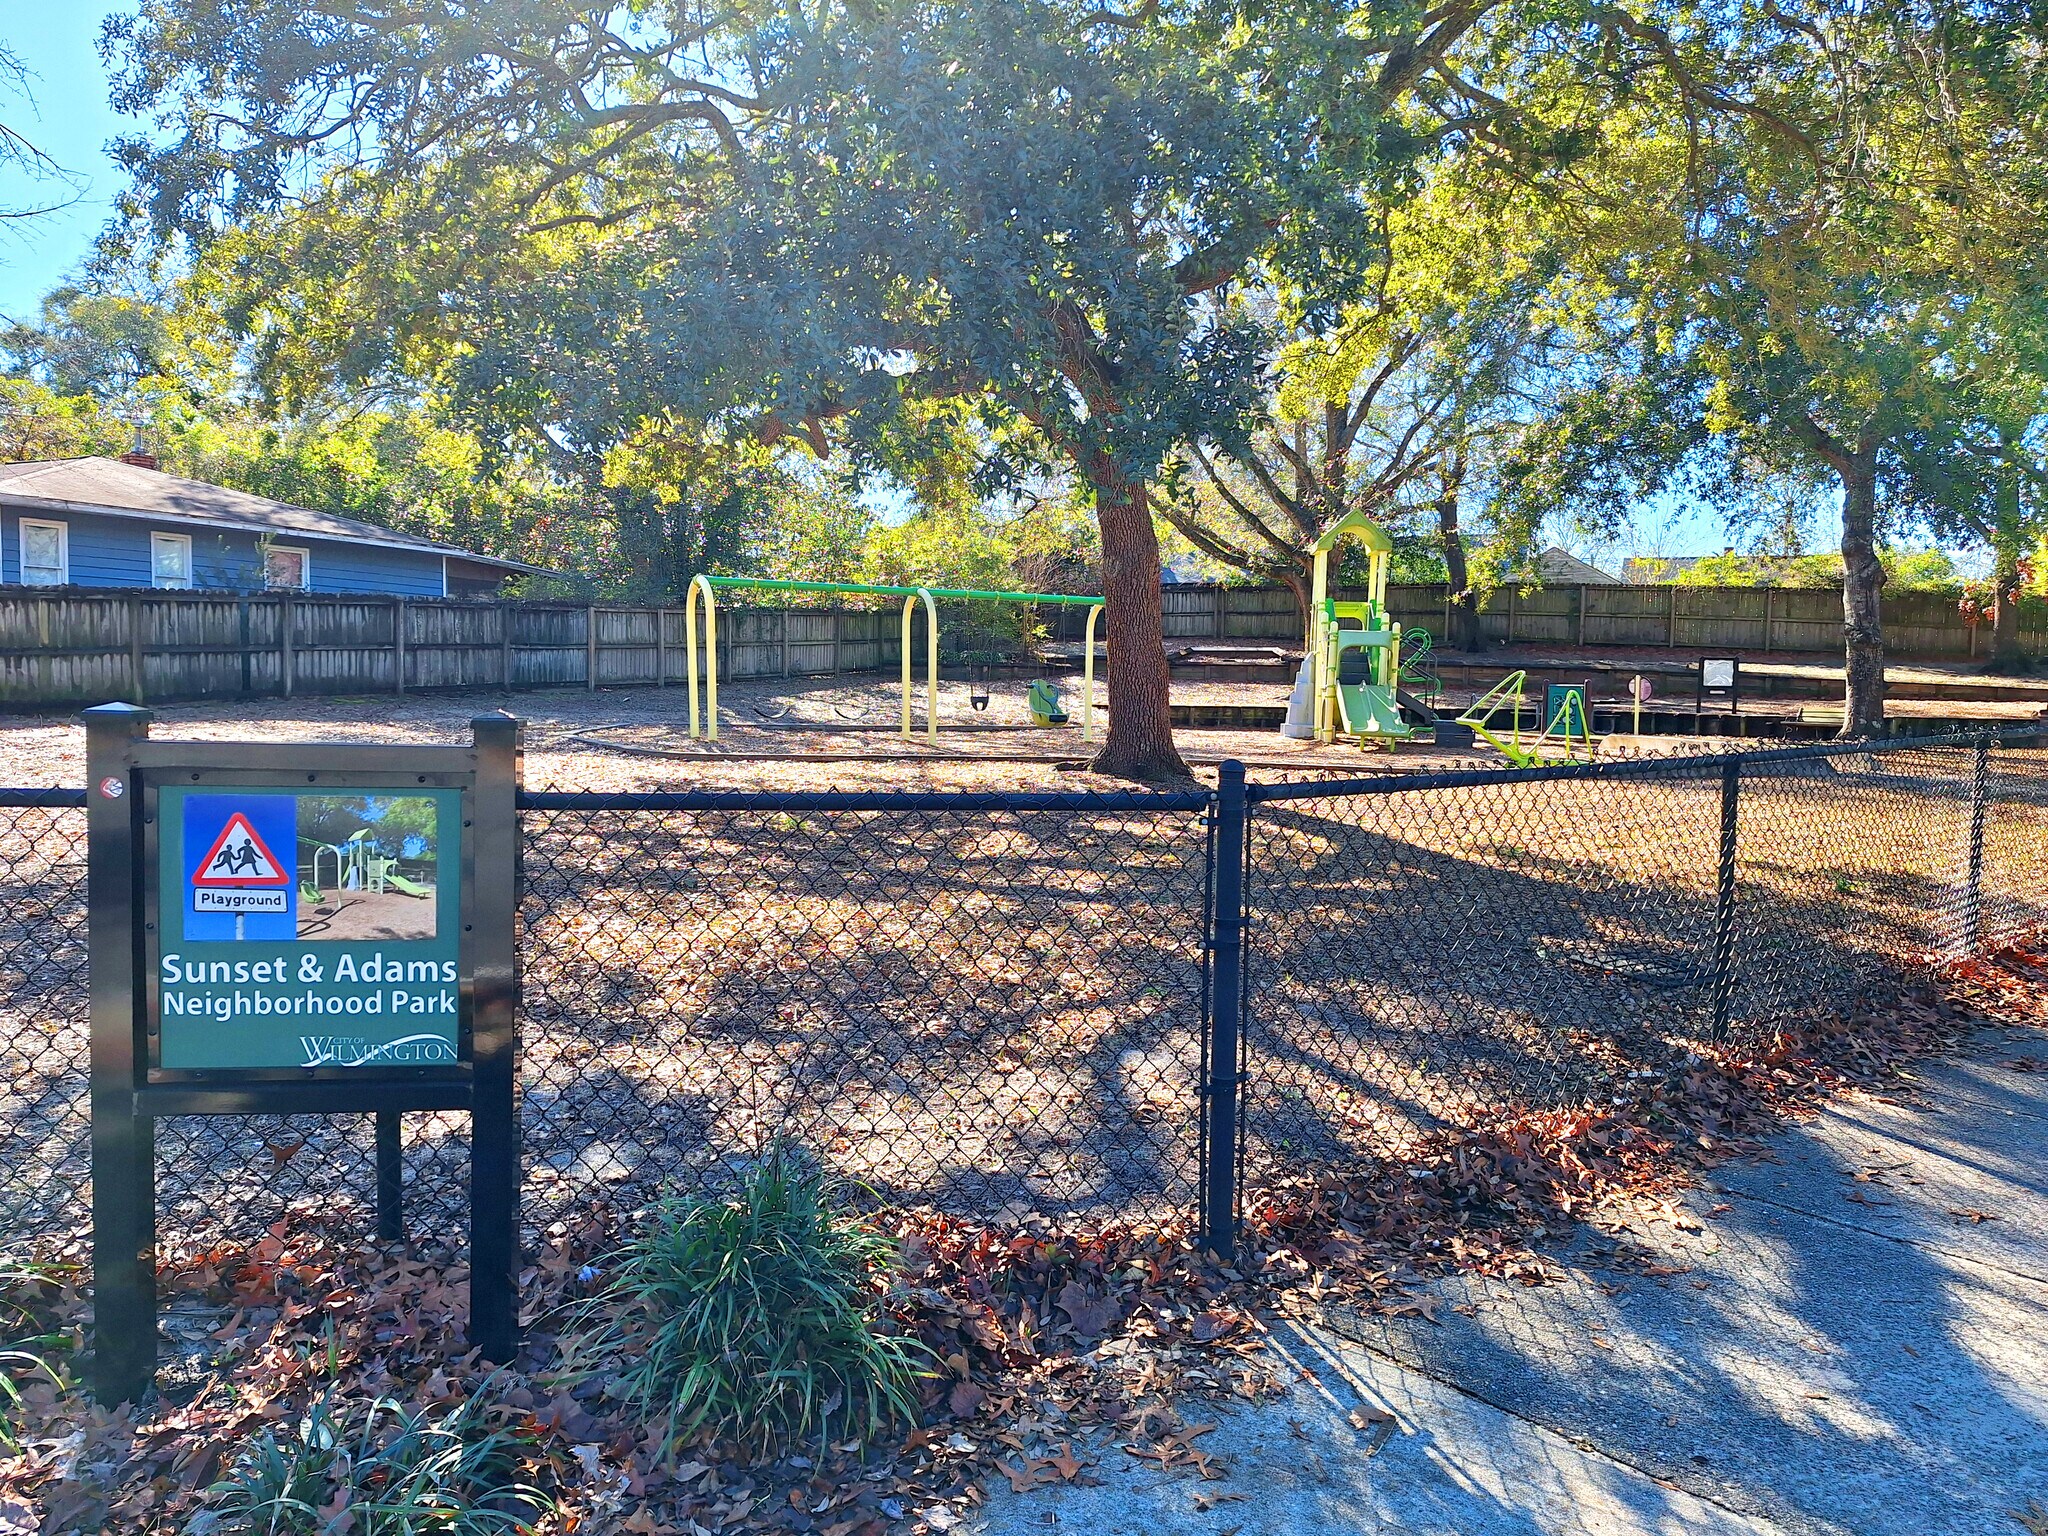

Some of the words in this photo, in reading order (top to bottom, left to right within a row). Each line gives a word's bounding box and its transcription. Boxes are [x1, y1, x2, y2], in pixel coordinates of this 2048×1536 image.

[201, 893, 282, 907] Playground
[162, 953, 288, 984] Sunset
[297, 953, 325, 983] &
[333, 952, 457, 982] Adams
[163, 989, 382, 1022] Neighborhood
[391, 989, 456, 1014] Park
[299, 1036, 459, 1062] WILMINGTON
